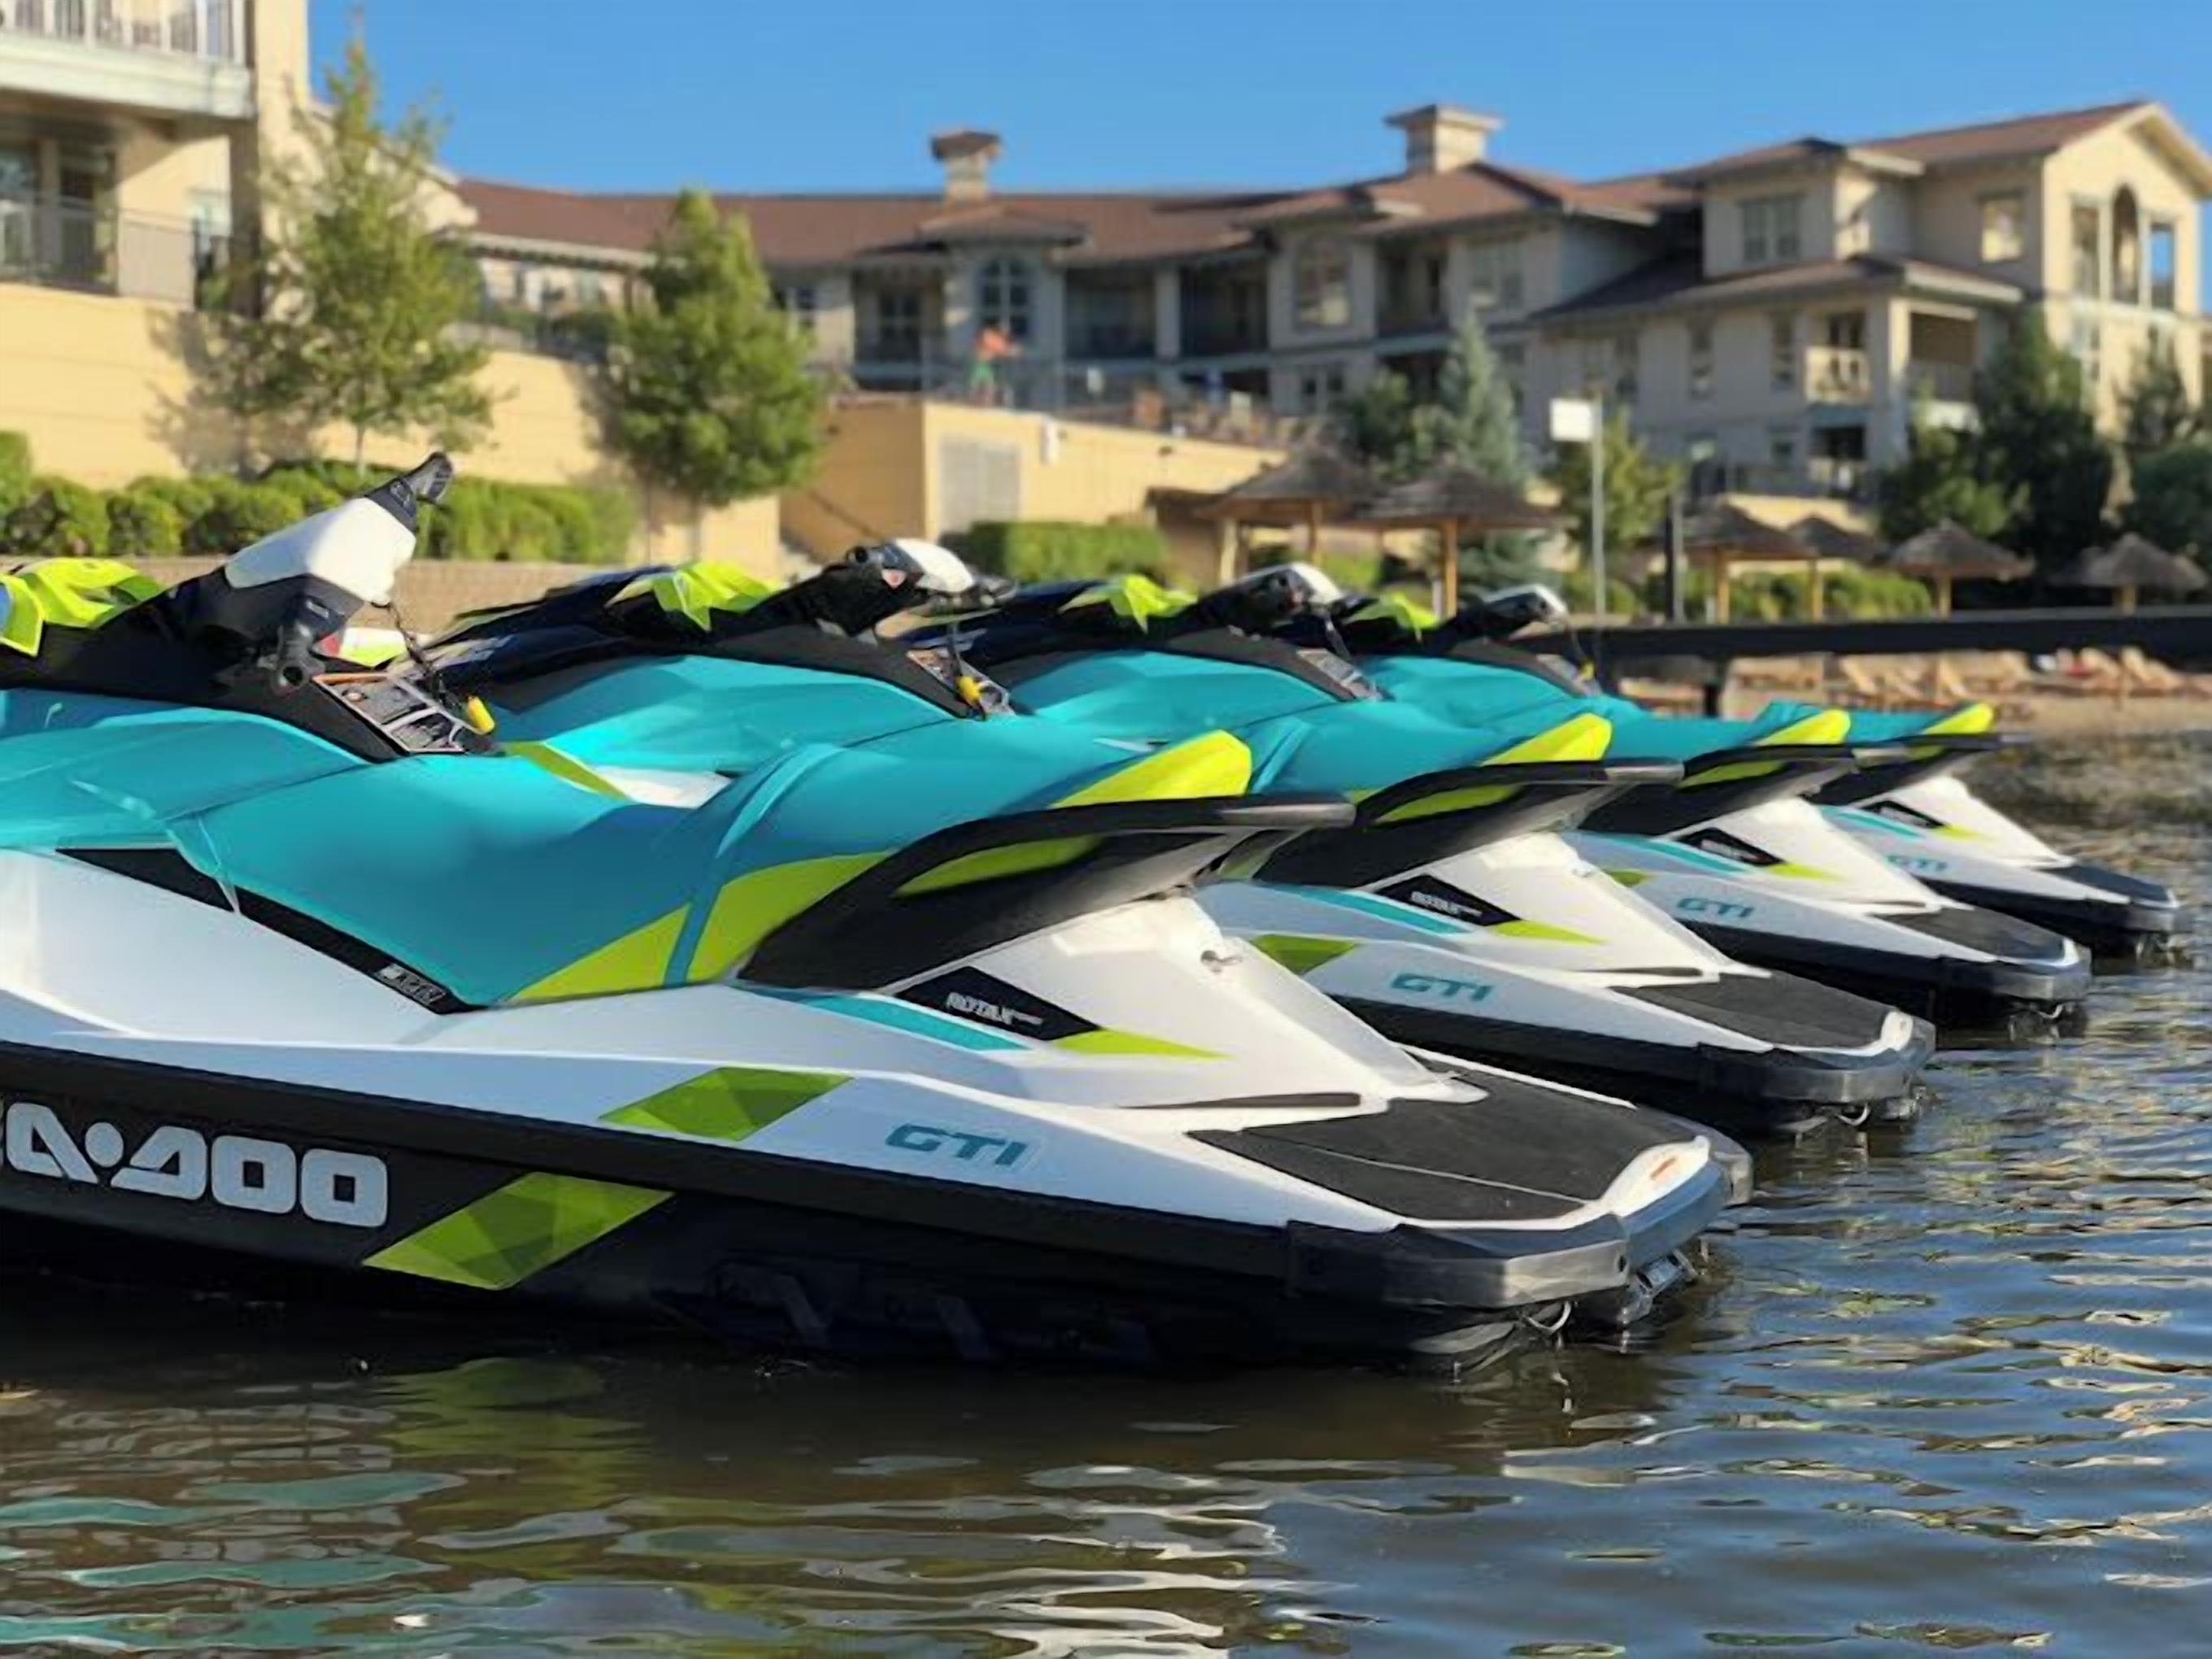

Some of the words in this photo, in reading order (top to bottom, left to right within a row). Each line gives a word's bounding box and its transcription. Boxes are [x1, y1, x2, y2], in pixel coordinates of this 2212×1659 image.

[1677, 897, 1755, 919] GTI
[1391, 973, 1493, 1003] GTI
[885, 1123, 1029, 1166] GTI
